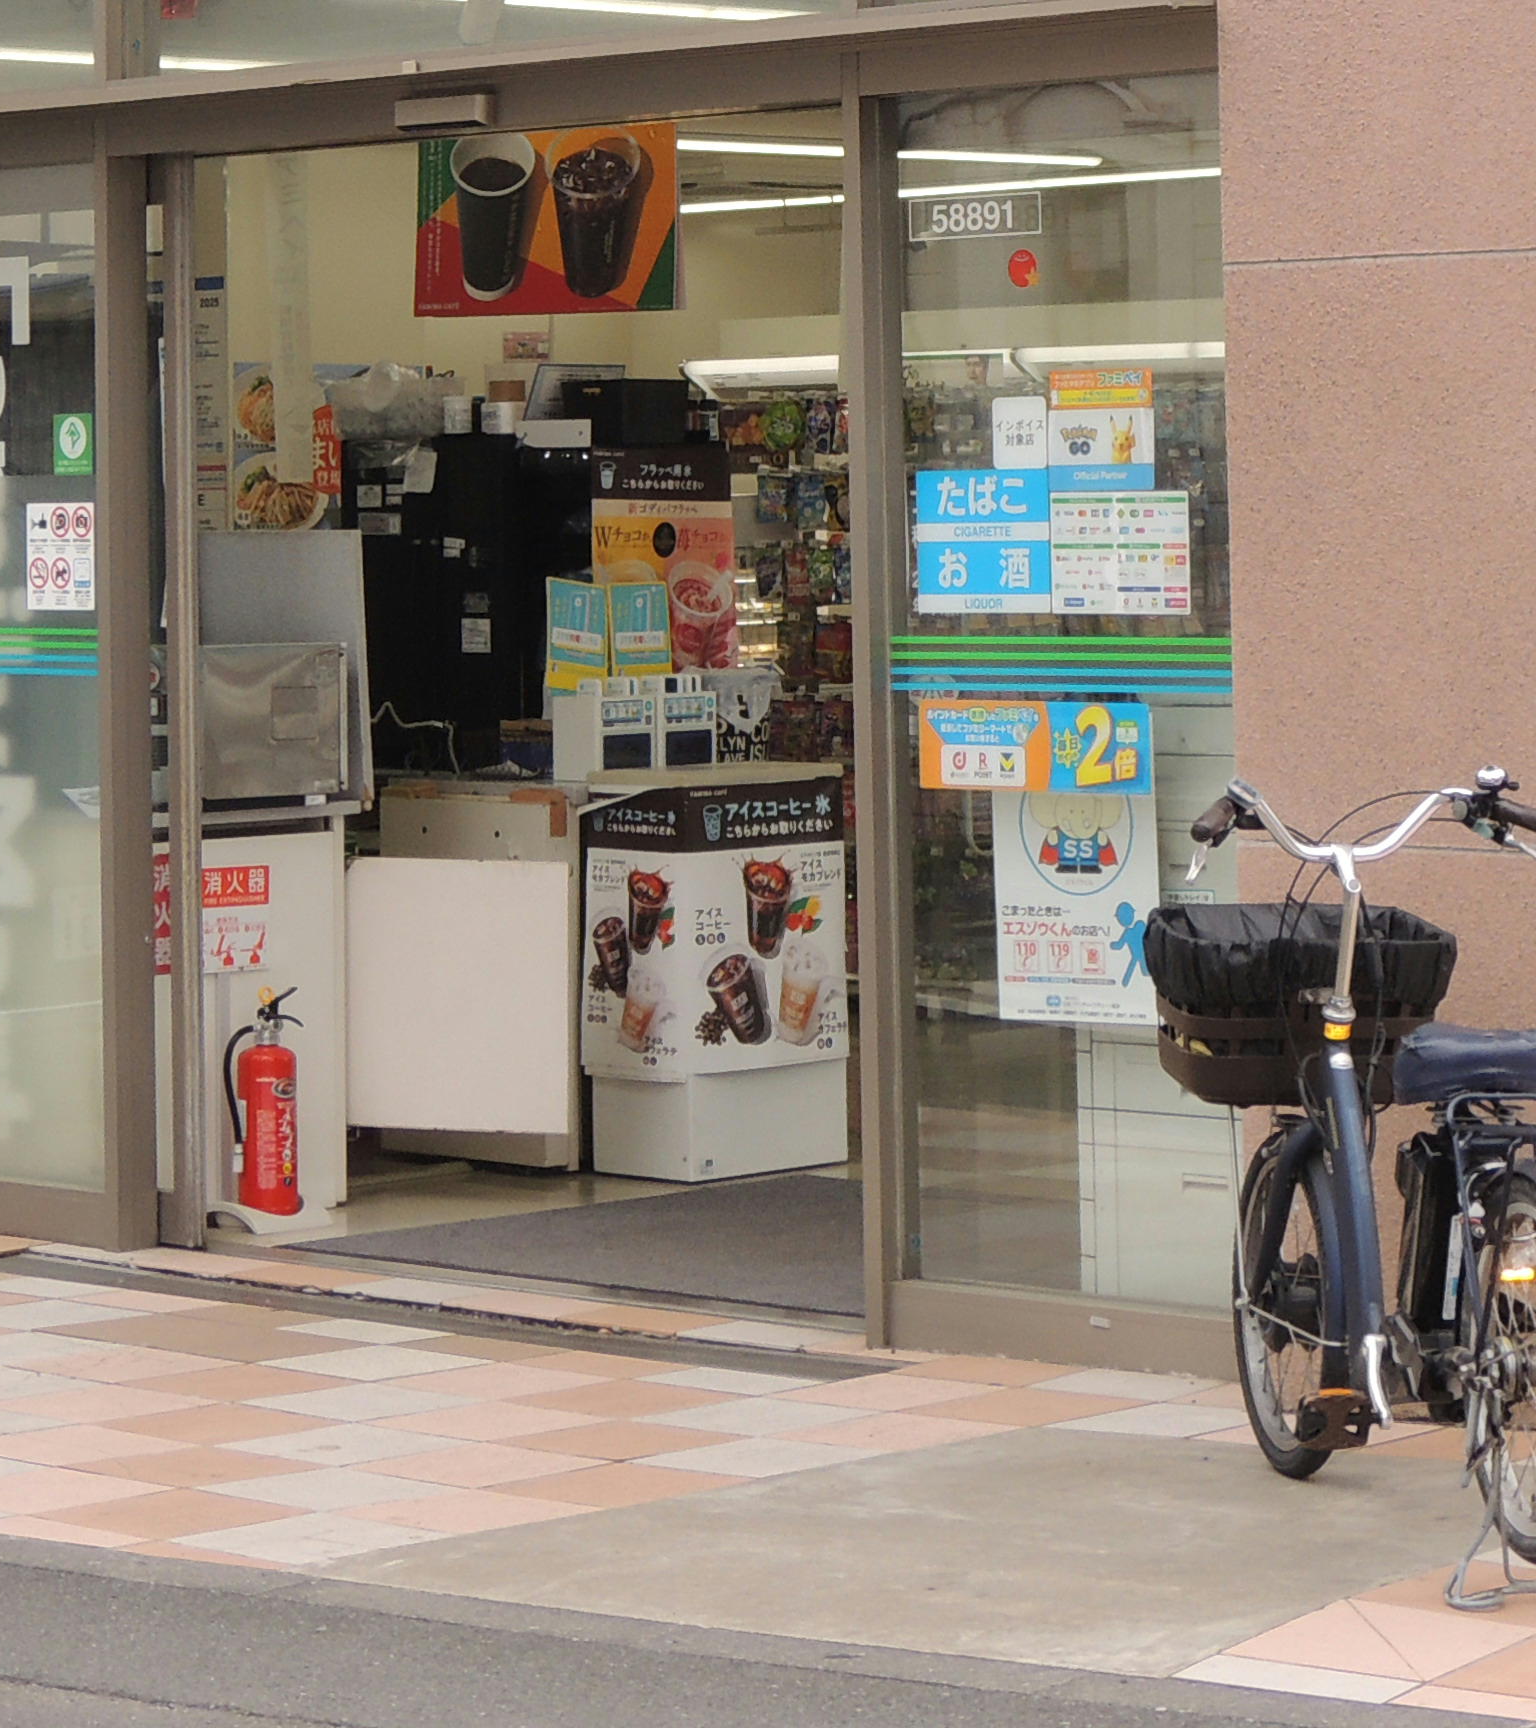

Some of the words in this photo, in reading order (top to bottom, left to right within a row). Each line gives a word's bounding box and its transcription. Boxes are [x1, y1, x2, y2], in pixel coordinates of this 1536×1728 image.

[932, 200, 1015, 234] 58891
[199, 297, 220, 308] 2025
[1097, 371, 1143, 385] ファミペイ
[995, 419, 1045, 433] インボイス
[1004, 432, 1035, 447] 対象店
[1068, 441, 1092, 456] GO
[1073, 472, 1098, 481] Official
[1099, 471, 1127, 480] Partner
[937, 475, 1028, 516] たばこ
[953, 526, 1012, 537] CIGARETTE
[964, 599, 1003, 610] LIQUOR
[725, 799, 812, 822] アイスコーヒー
[815, 793, 832, 816] 氷
[607, 808, 666, 823] アイスコーヒー
[725, 819, 834, 839] こちらからお取りください
[1064, 839, 1093, 858] SS
[800, 859, 823, 870] アイス
[204, 869, 266, 895] 消火器
[153, 863, 171, 966] 消火器
[695, 908, 722, 920] アイス
[695, 921, 731, 932] コーヒー
[1016, 942, 1037, 957] 110
[1049, 942, 1070, 957] 119
